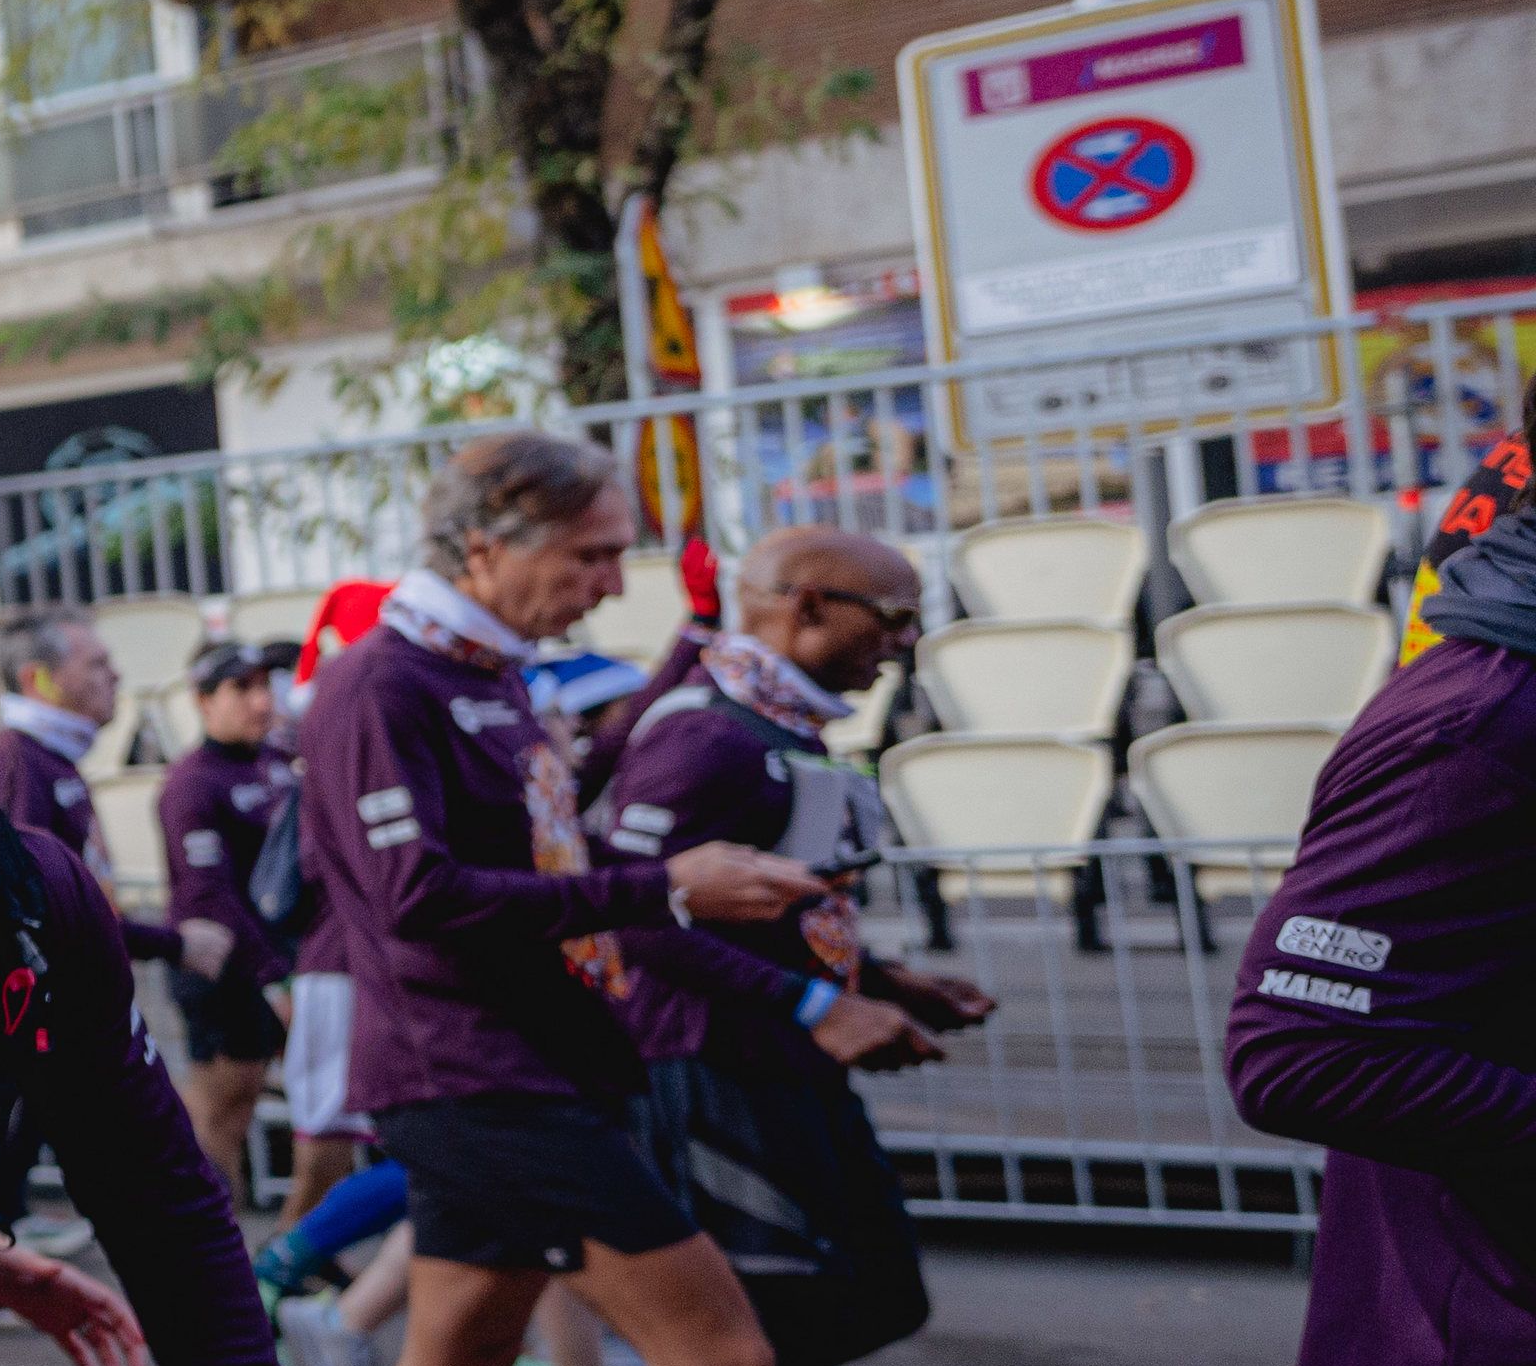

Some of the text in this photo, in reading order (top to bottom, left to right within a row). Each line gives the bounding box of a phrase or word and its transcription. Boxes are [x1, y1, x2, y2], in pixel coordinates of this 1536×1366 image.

[1291, 919, 1346, 942] SANI
[1281, 934, 1378, 967] CENTRO
[1256, 968, 1372, 1015] MARCA
